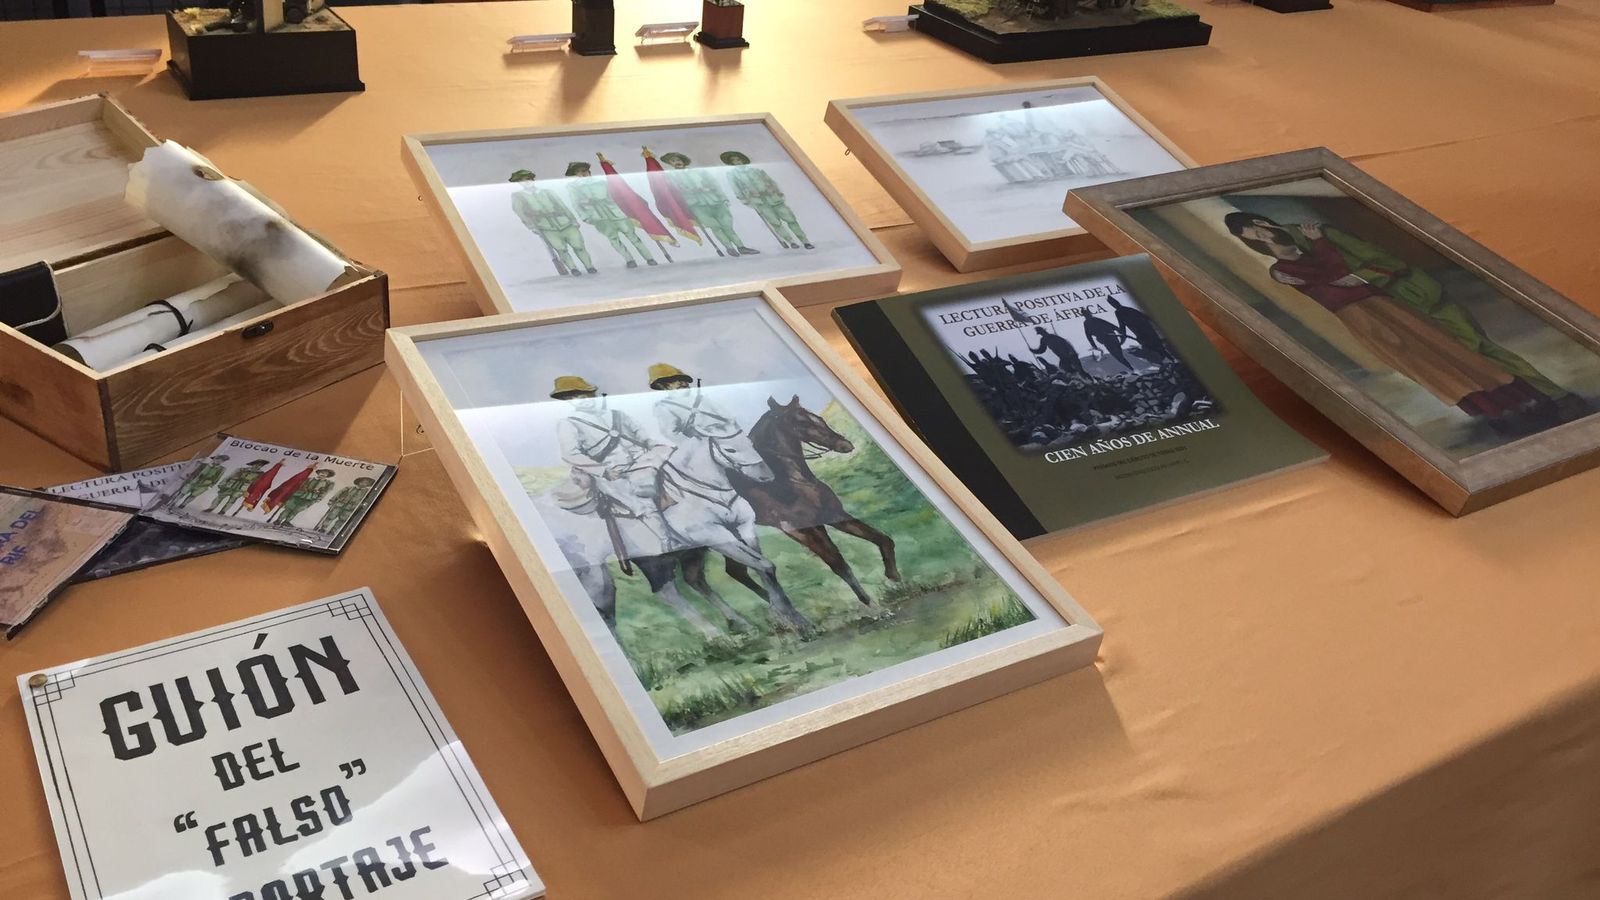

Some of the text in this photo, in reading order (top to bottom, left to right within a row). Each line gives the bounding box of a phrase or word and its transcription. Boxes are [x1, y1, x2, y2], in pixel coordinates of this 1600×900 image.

[939, 283, 1127, 324] LECTURA POSITIVA DE LA
[963, 303, 1108, 337] GUERRA DE ÁFRICA
[230, 440, 375, 471] Blocao de la Muerte
[1044, 445, 1088, 464] CIEN
[1090, 436, 1132, 454] AÑOS
[1131, 431, 1157, 446] DE
[1159, 419, 1220, 440] ANNUAL
[52, 462, 186, 494] LECTURA POSITI
[99, 633, 360, 761] GUIÓN
[211, 737, 300, 791] DEL
[229, 825, 449, 900] RTAJE
